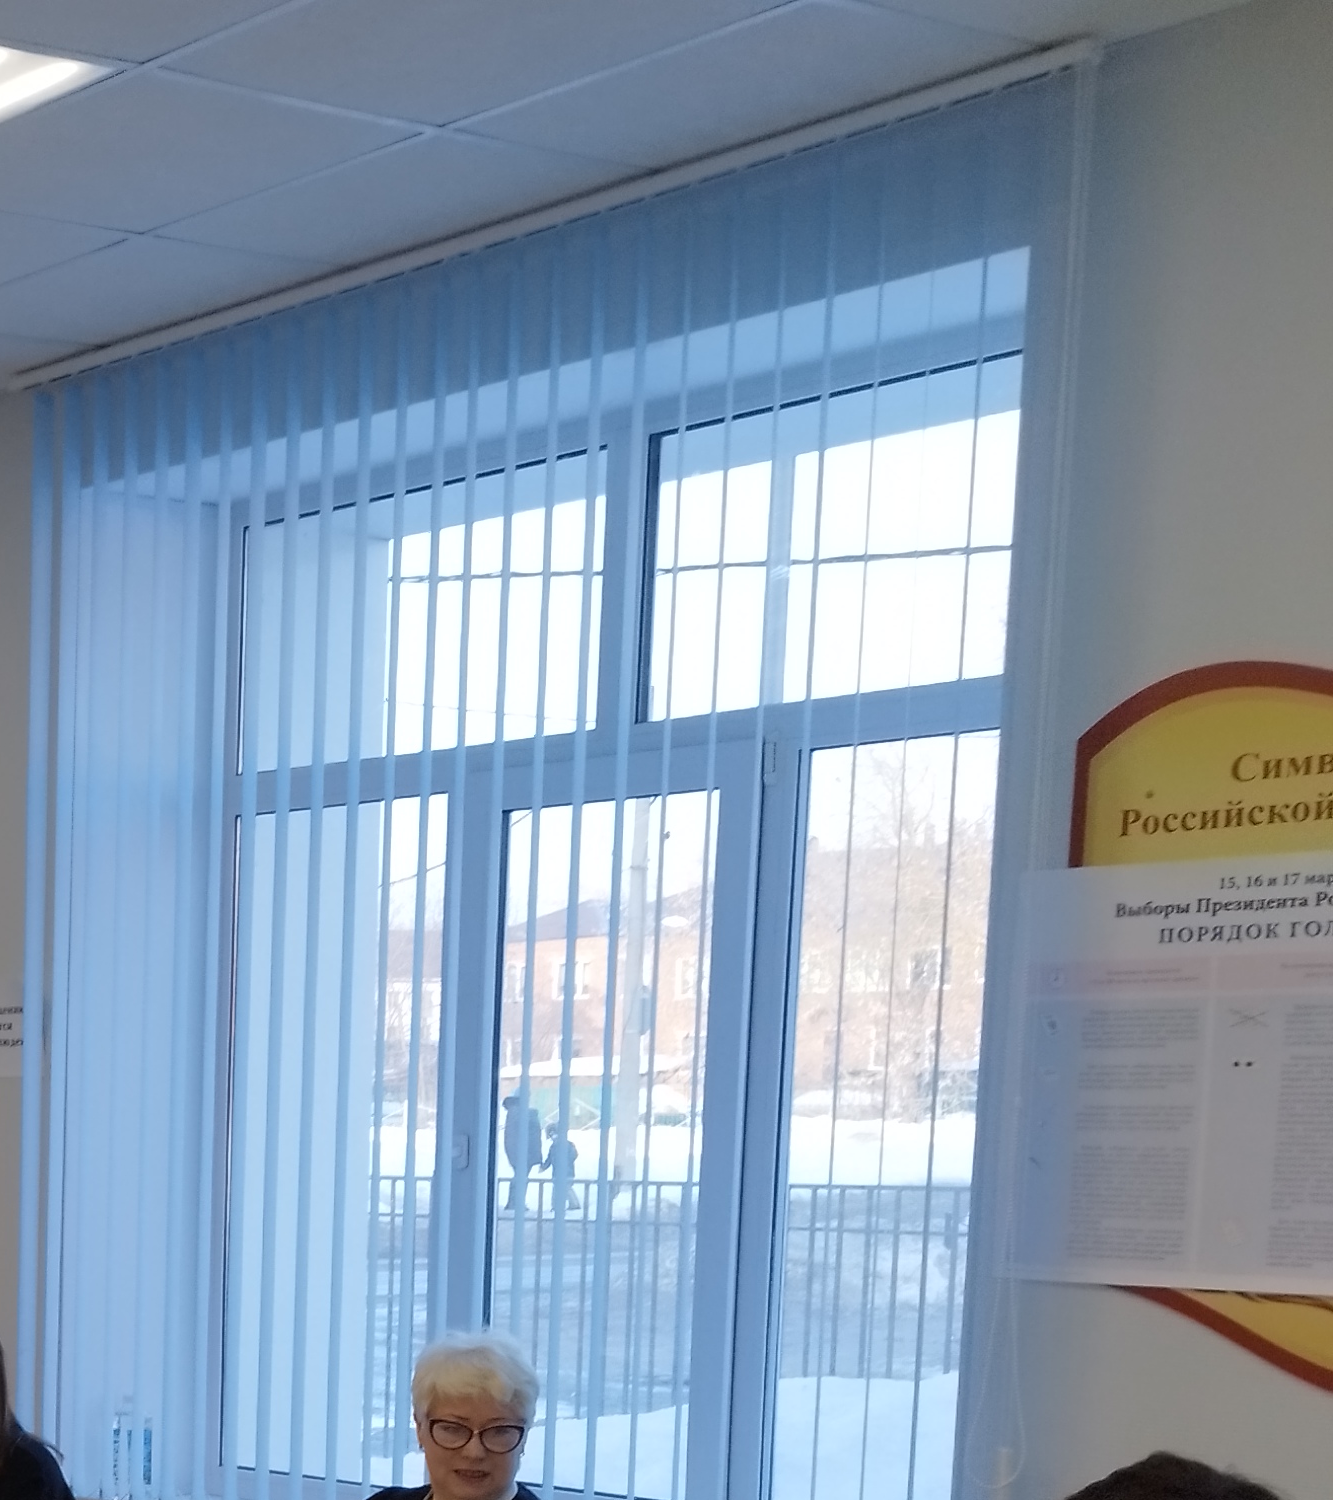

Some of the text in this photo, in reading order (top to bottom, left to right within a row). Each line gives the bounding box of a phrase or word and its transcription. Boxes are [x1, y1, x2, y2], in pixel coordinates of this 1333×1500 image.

[1231, 752, 1333, 782] Симв
[1119, 791, 1333, 837] Российской
[1219, 876, 1240, 890] 15,
[1246, 874, 1263, 888] 16
[1267, 877, 1277, 887] и
[1283, 872, 1301, 886] 17
[1115, 901, 1190, 919] Выборы
[1195, 897, 1308, 917] Президента
[1158, 922, 1280, 944] ПОРЯДОК
